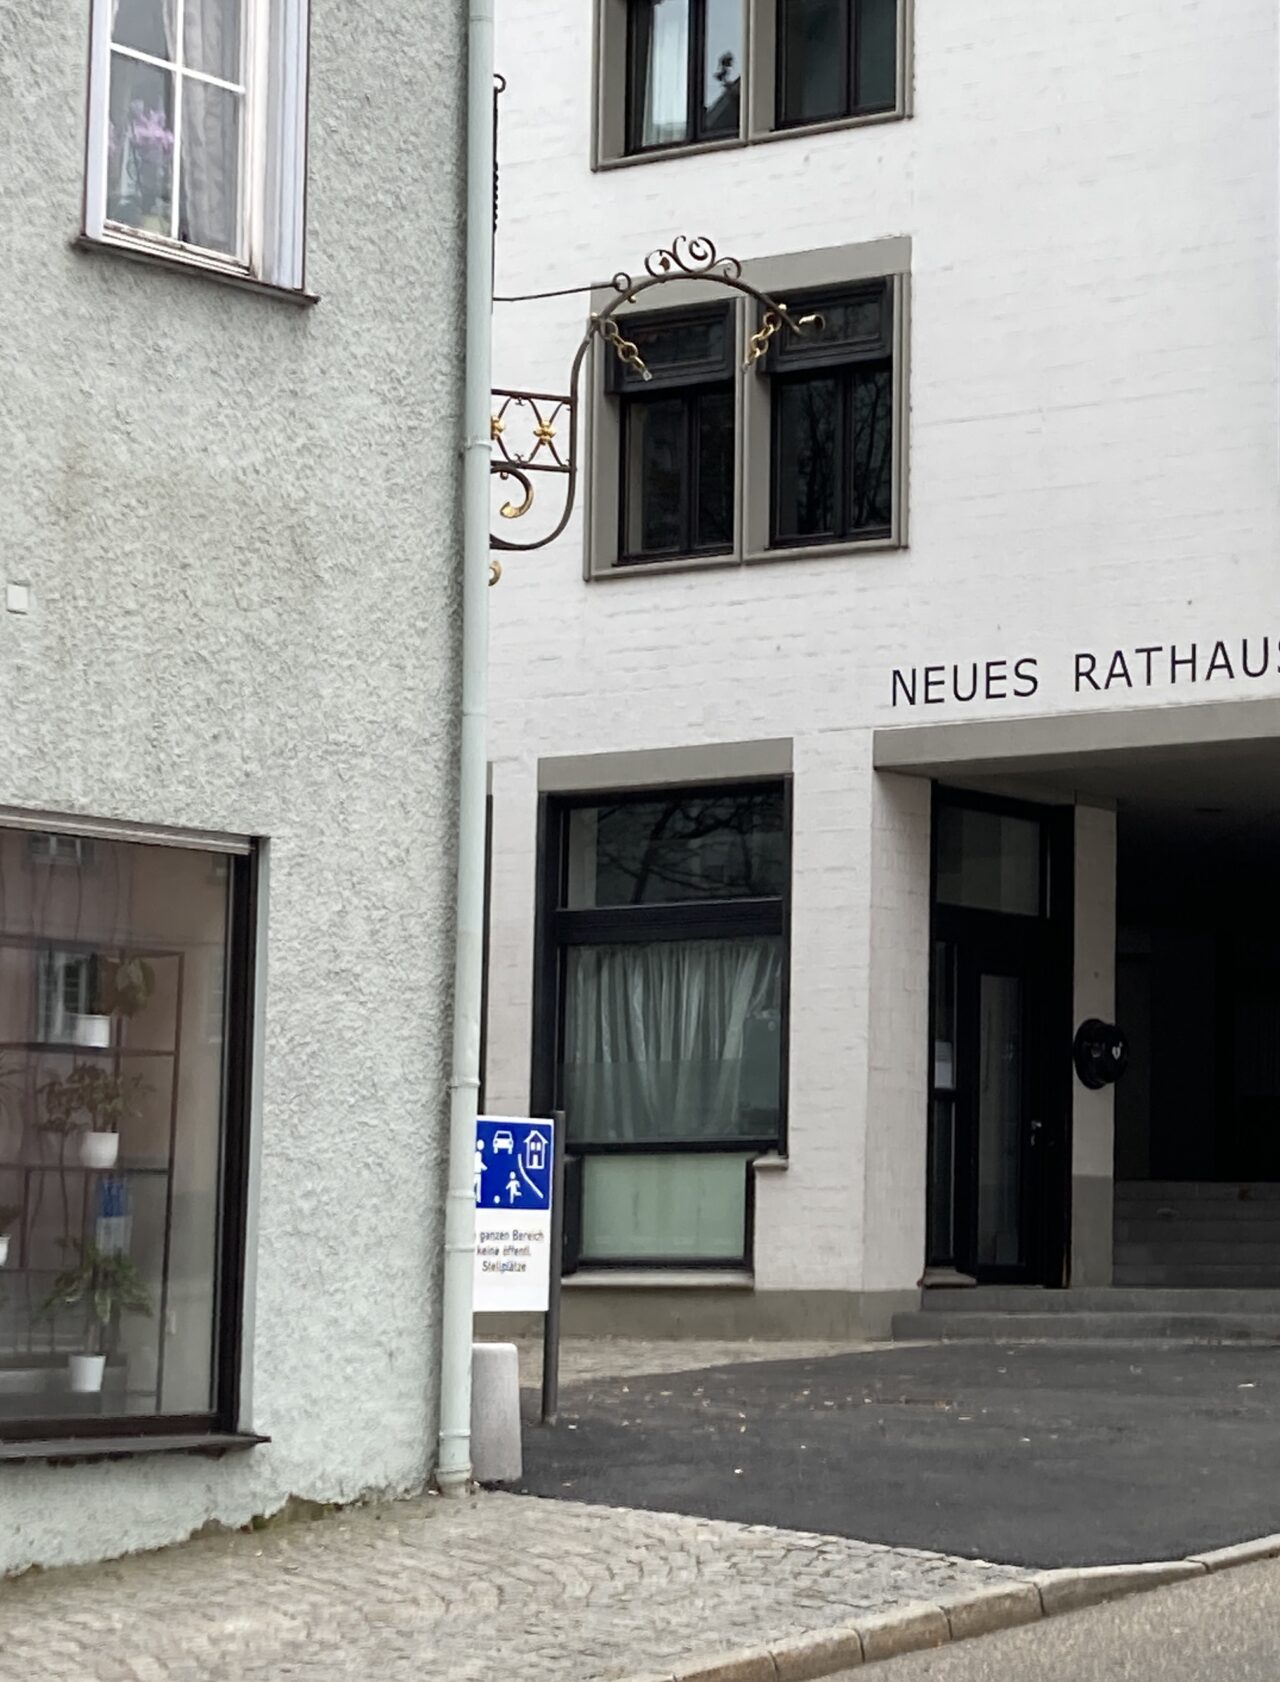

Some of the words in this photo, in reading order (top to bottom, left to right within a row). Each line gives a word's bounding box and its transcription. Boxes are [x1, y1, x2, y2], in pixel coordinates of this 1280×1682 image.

[892, 657, 1039, 707] NEUES
[479, 1231, 510, 1243] ganzen
[512, 1229, 544, 1242] Bereich
[476, 1244, 500, 1256] keine
[482, 1260, 527, 1274] Stellplätze
